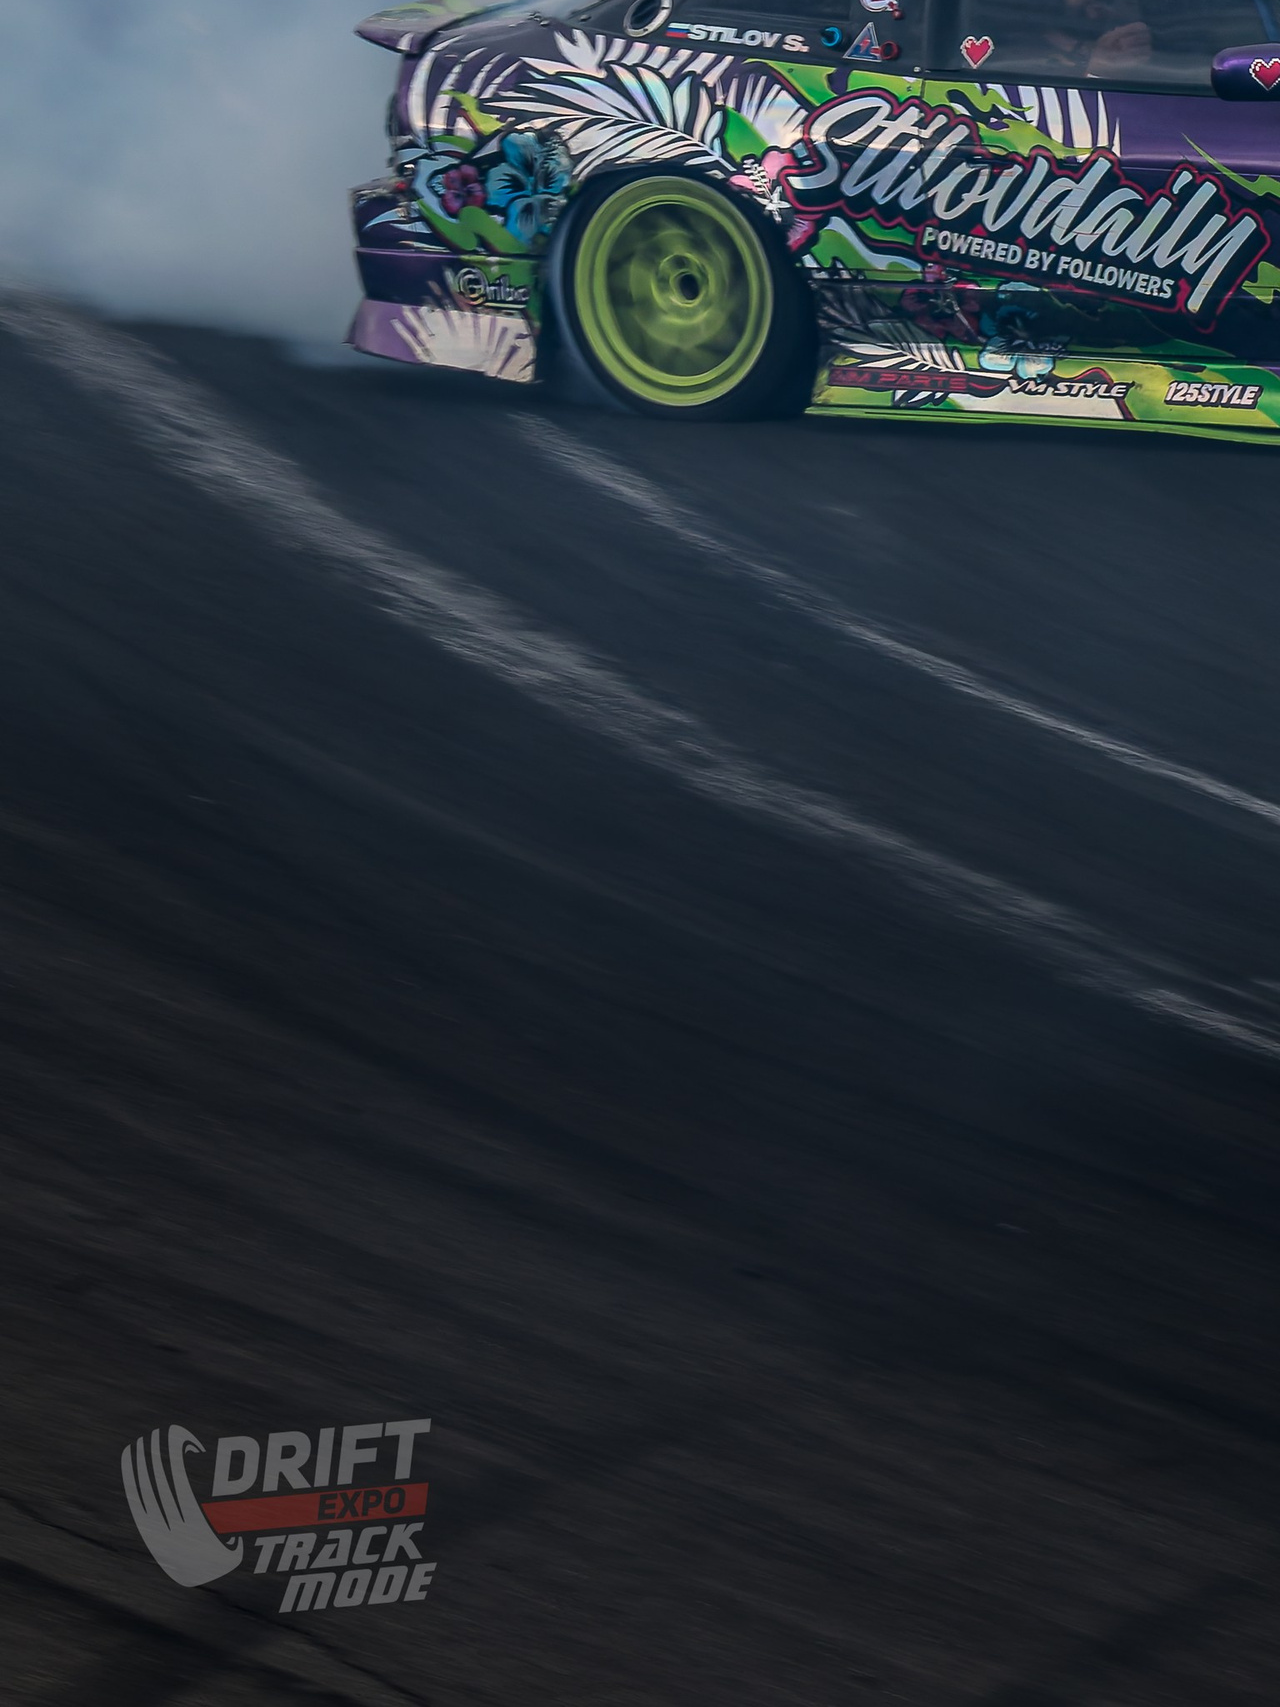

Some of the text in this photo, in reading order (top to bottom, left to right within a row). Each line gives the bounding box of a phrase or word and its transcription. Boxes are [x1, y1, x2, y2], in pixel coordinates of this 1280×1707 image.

[687, 24, 782, 48] STILOV
[922, 226, 1175, 299] POWERED BY FOLLOWERS
[1164, 381, 1260, 406] 125STYLE
